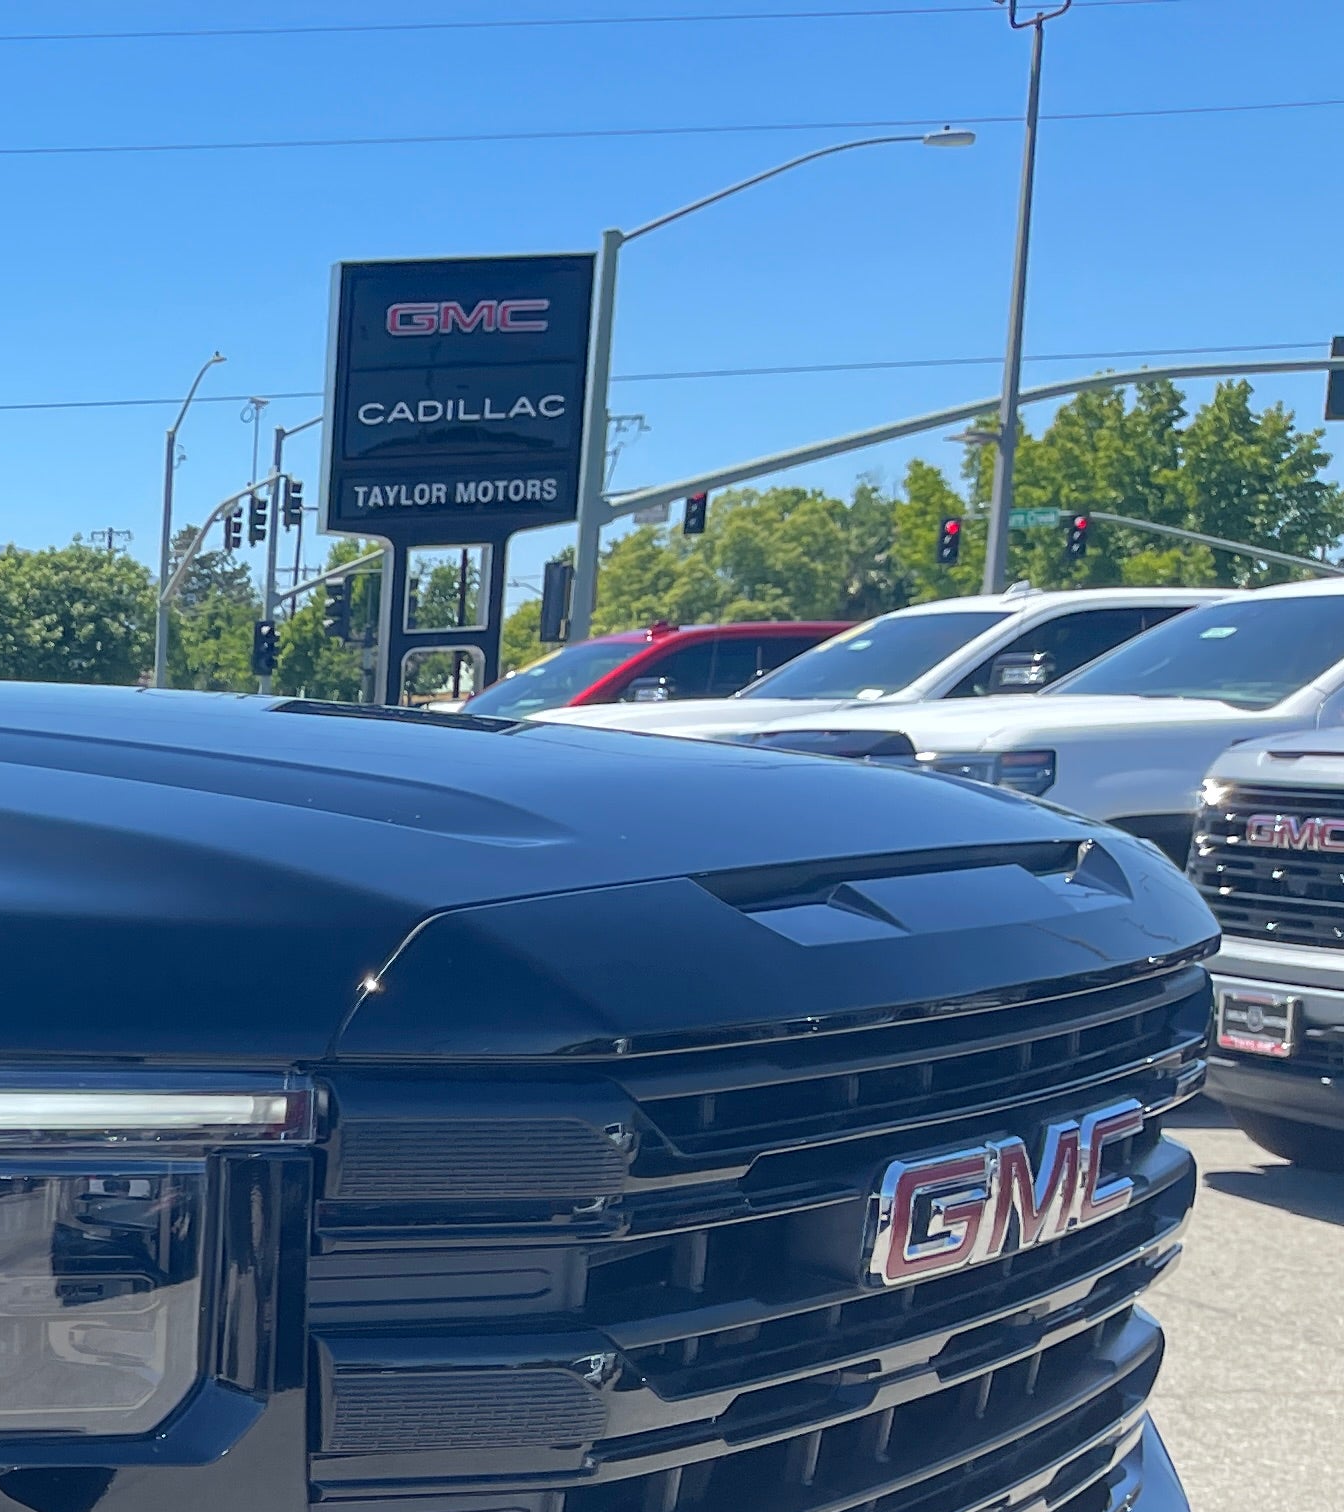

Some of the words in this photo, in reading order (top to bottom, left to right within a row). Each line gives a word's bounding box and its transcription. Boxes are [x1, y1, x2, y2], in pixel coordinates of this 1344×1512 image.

[386, 298, 550, 336] GMC
[358, 394, 565, 425] CADILLAC
[354, 483, 447, 508] TAYLOR
[455, 478, 558, 503] MOTORS
[1246, 813, 1344, 853] GMC
[870, 1098, 1144, 1287] GMC
